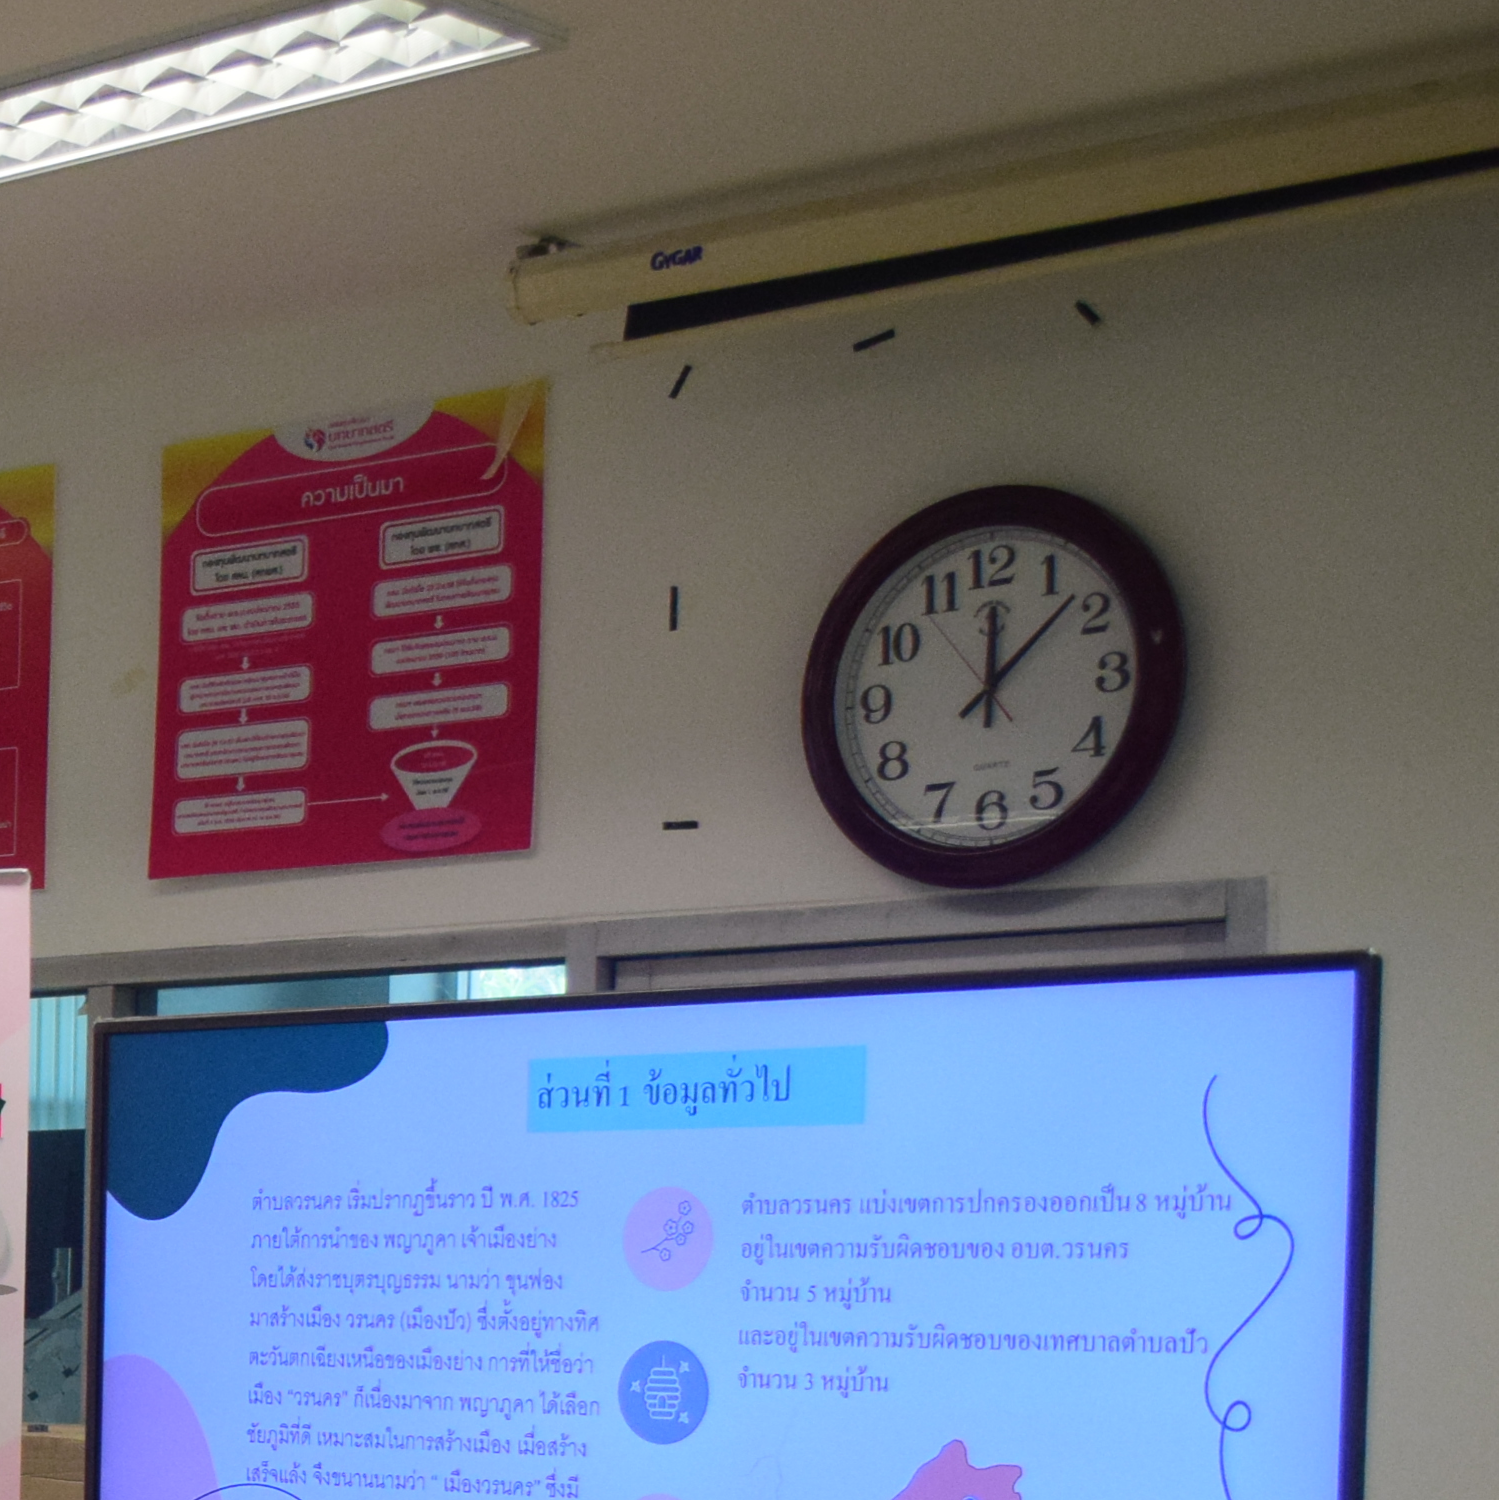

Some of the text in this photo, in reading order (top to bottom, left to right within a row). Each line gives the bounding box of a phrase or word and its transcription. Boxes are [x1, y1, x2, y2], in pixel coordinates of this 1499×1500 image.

[300, 474, 404, 509] ความเป็นมา
[968, 544, 1016, 591] 12
[1042, 554, 1059, 596] 1
[921, 571, 959, 616] 11
[1080, 592, 1110, 635] 2
[878, 622, 921, 666] 10
[1095, 651, 1131, 693] 3
[861, 684, 893, 725] 9
[1071, 715, 1106, 758] 4
[877, 741, 910, 781] 8
[973, 760, 1011, 771] QUARTZ
[924, 781, 956, 824] 7
[1029, 767, 1064, 810] 5
[976, 790, 1008, 831] 6
[538, 1054, 791, 1116] ส่วนที่ 1 ข้อมูลทั่วไป
[253, 1189, 342, 1211] ตำบลวรนคร
[481, 1186, 494, 1208] ปี
[501, 1191, 535, 1208] พ.ศ.
[542, 1190, 579, 1208] 1825
[742, 1193, 852, 1216] ตำบลวรนคร
[1136, 1193, 1148, 1213] 8
[1155, 1184, 1231, 1219] หมู่บ้าน
[251, 1225, 557, 1255] ภายใต้การนำของ พญาภูคา เจ้าเมืองย่าง
[741, 1233, 1130, 1265] อยู่ในเขตความรับผิดชอบของ อบต.วรนคร
[251, 1266, 564, 1296] โดยได้ส่งราชบุตรบุญธรรม นามว่า ขุนฟอง
[740, 1277, 892, 1311] จำนวน 5 หมู่บ้าน
[250, 1299, 599, 1338] มาสร้างเมือง วรนคร (เมืองปัว) ซึ่งตั้งอยู่ทางทิศ
[738, 1322, 1208, 1355] และอยู่ในเขตความรับผิดชอบของเทศบาลตำบลปัว
[249, 1342, 594, 1374] ตะวันตกเฉียงเหนือของเมืองย่าง การที่ให้ชื่อว่า
[249, 1382, 282, 1406] เมือง
[353, 1379, 454, 1410] ก็เนื่องมาจาก
[459, 1396, 534, 1420] พญาภูคา
[539, 1391, 601, 1416] ได้เลือก
[738, 1366, 889, 1399] จำนวน 3 หมู่บ้าน
[247, 1416, 587, 1458] ชัยภูมิที่ดี เหมาะสมในการสร้างเมือง เมื่อสร้าง
[313, 1462, 426, 1491] จึงขนานนามว่า
[545, 1468, 579, 1499] ซึ่งมี
